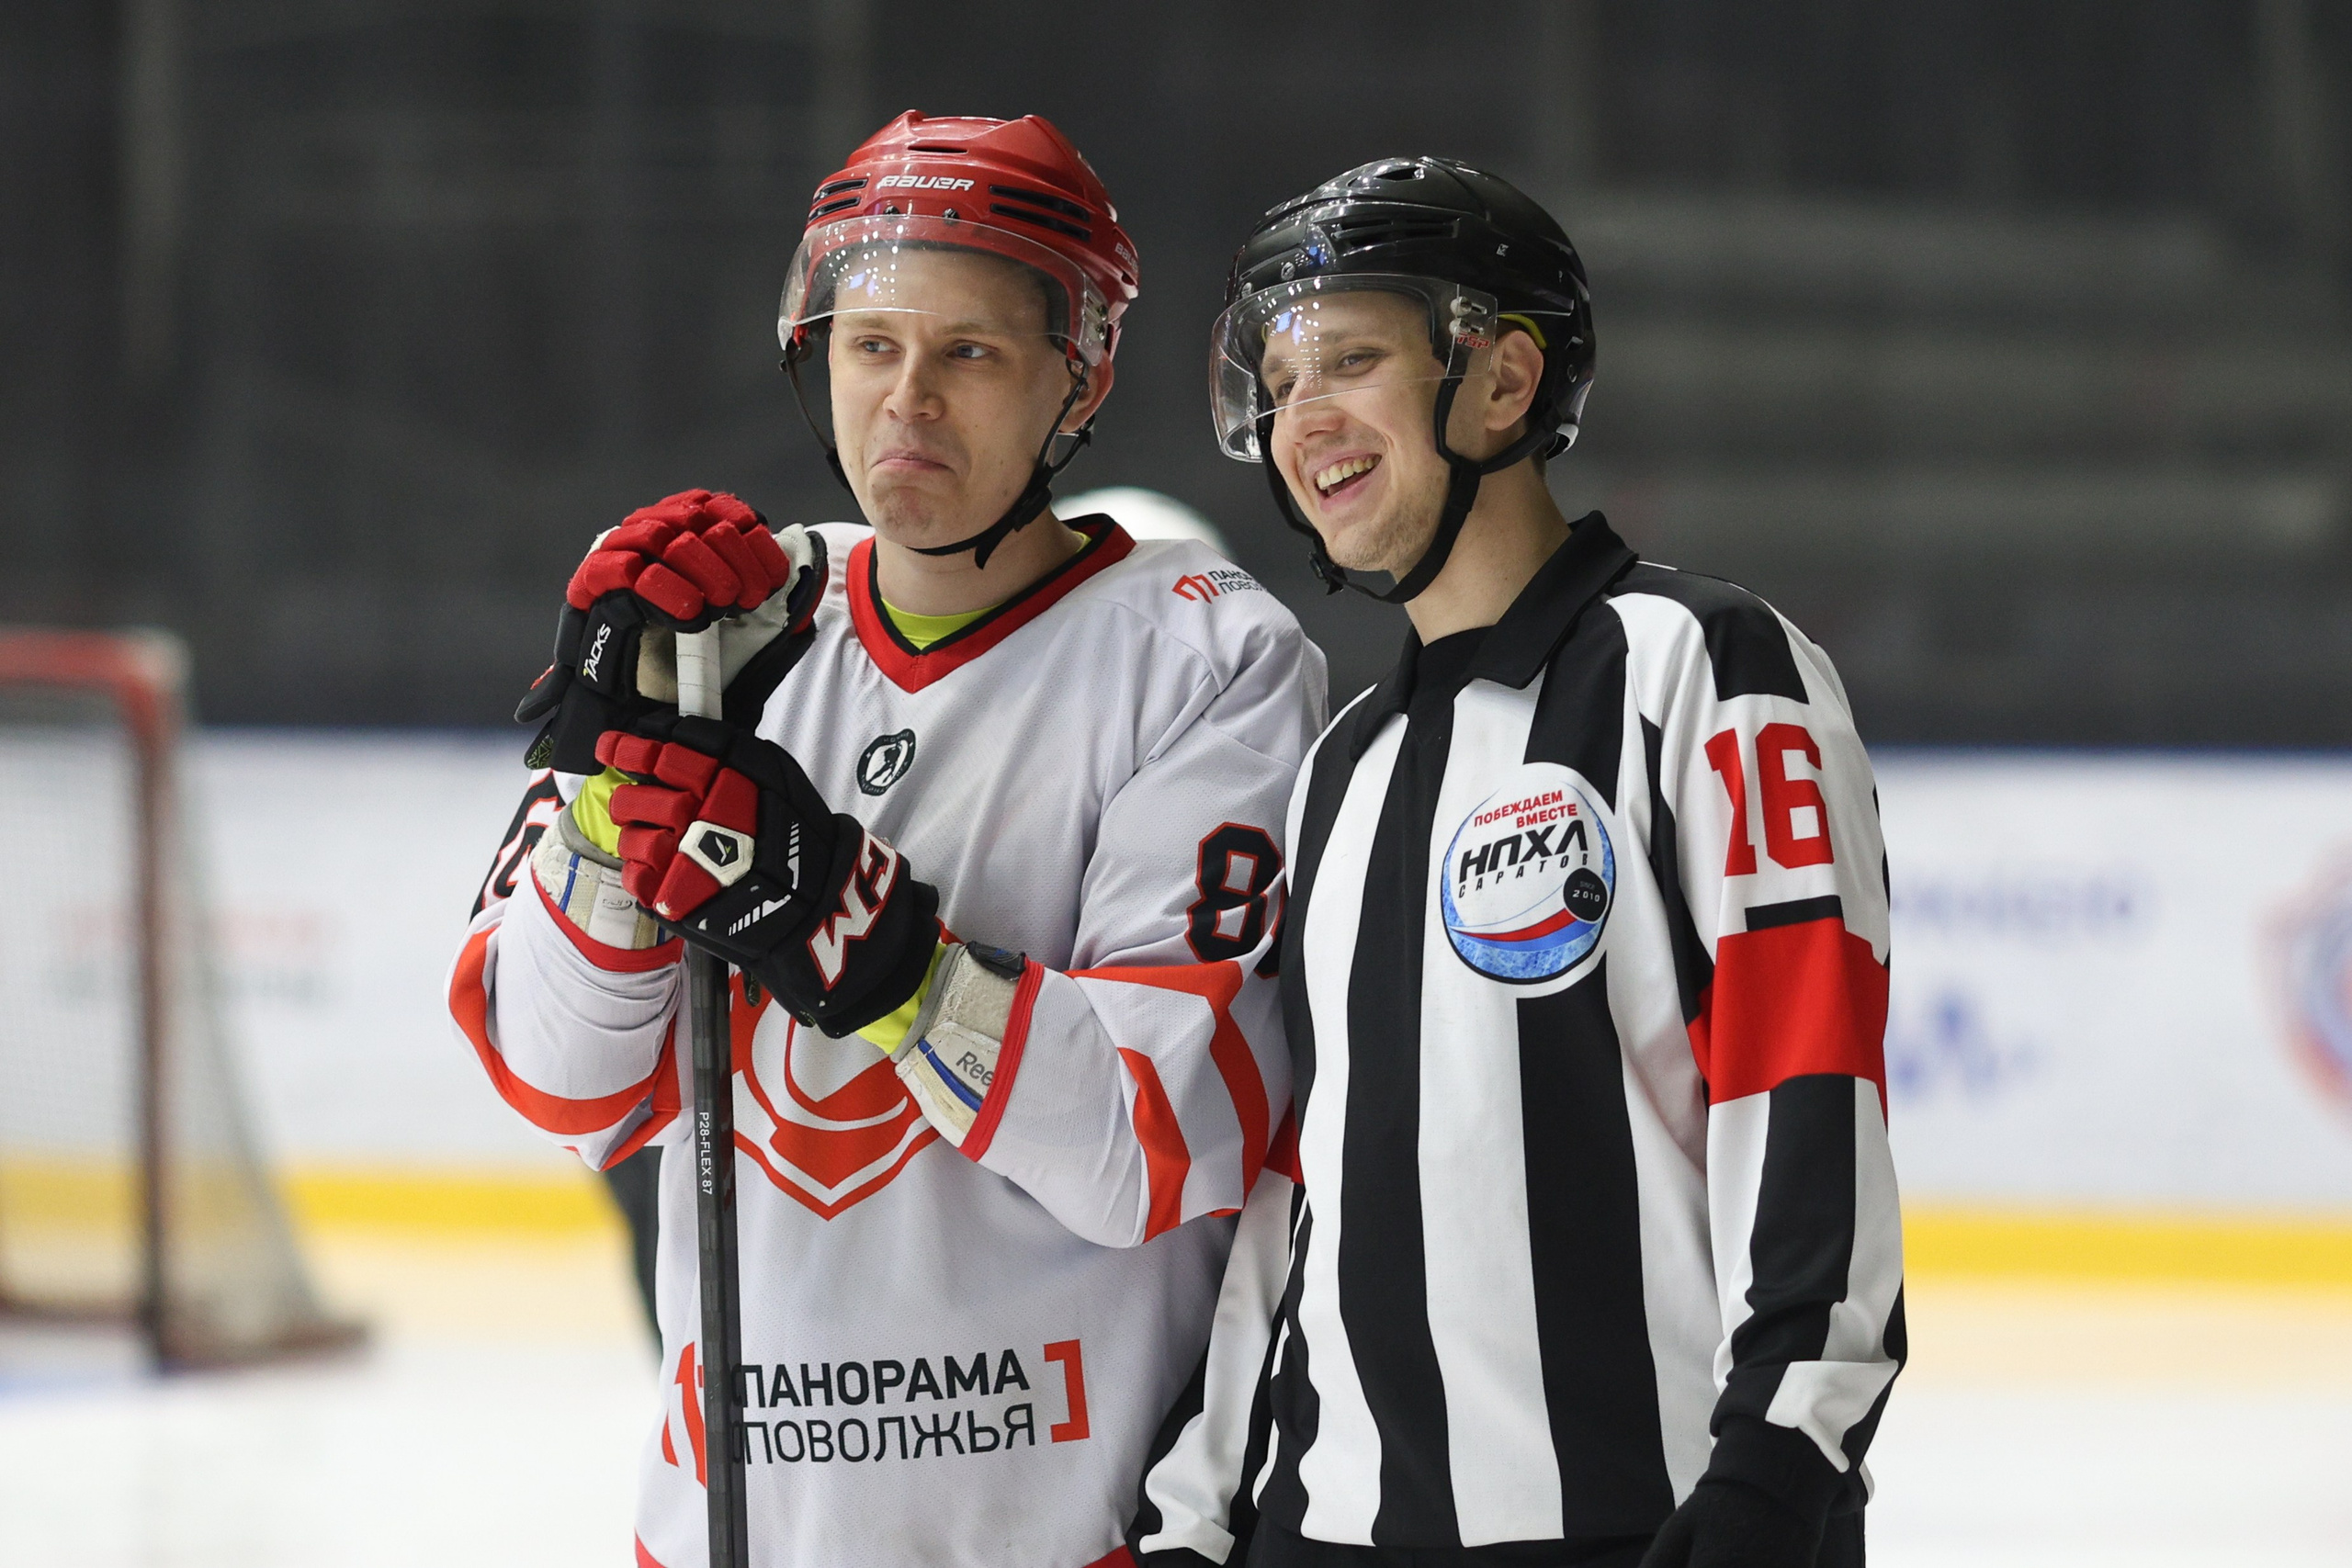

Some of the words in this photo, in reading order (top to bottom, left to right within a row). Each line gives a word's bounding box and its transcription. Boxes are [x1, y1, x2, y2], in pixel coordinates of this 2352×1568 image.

[582, 623, 611, 682] TACKS
[1474, 789, 1564, 828] ПОБЕЖДАЕМ
[1516, 804, 1578, 829] ВМЕСТЕ
[1704, 722, 1835, 877] 16
[1458, 819, 1589, 884] НПХЛ
[1458, 853, 1589, 898] САРАТОВ
[1572, 889, 1600, 903] 2010
[956, 1051, 994, 1087] Ree
[699, 1111, 712, 1177] P28-FLEX
[702, 1179, 713, 1195] 87
[739, 1348, 1031, 1409] ПАНОРАМА
[743, 1403, 1036, 1465] ПОВОЛЖЬЯ
